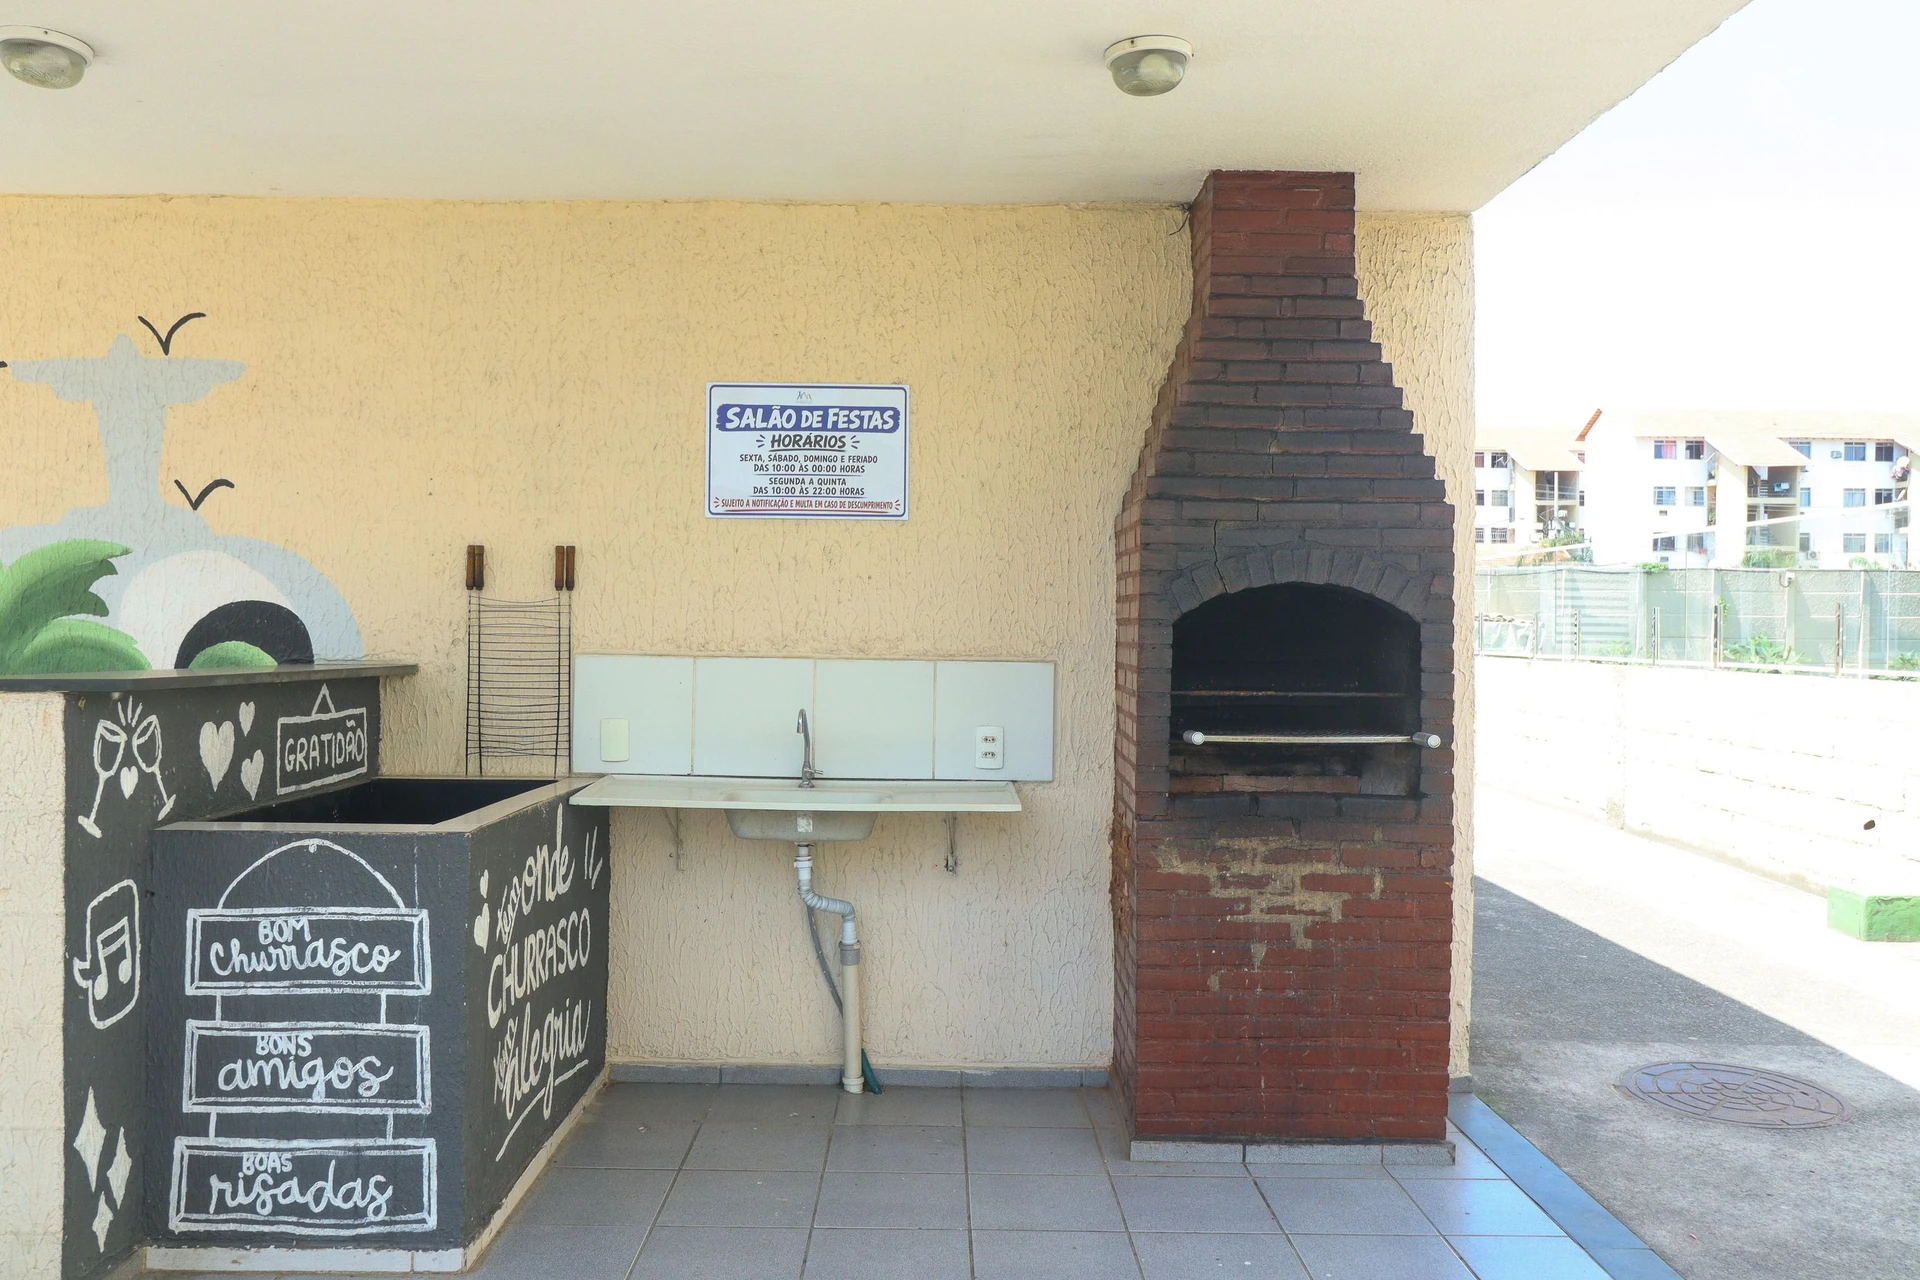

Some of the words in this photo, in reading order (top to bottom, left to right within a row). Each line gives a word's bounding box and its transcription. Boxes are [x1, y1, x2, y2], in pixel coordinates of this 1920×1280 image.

[725, 404, 797, 430] SALÃO
[800, 409, 824, 430] DE
[826, 407, 895, 430] FESTAS
[770, 432, 847, 449] HORÁRIOS
[739, 453, 765, 463] SEXTA,
[767, 452, 801, 464] SÁBADO,
[803, 454, 838, 463] DOMINGO
[840, 455, 846, 463] E
[848, 455, 878, 464] FERIADO
[753, 463, 770, 472] DAS
[772, 463, 796, 472] 10:00
[798, 462, 809, 473] ÀS
[811, 464, 837, 473] 00:00
[839, 465, 866, 474] HORAS
[753, 486, 769, 495] DAS
[771, 486, 796, 495] 10:00
[798, 485, 810, 495] ÀS
[812, 486, 837, 496] 22:00
[839, 487, 865, 496] HORAS
[768, 477, 806, 486] SEGUNDA
[808, 477, 814, 486] A
[817, 477, 847, 486] QUINTA
[721, 498, 745, 508] SUJEITO
[745, 499, 750, 508] A
[751, 497, 789, 510] NOTIFICAÇÃO
[789, 499, 794, 508] E
[795, 499, 813, 509] MULTA
[814, 500, 824, 509] EM
[824, 500, 838, 509] CASO
[839, 500, 847, 509] DE
[847, 500, 894, 510] DESCUMPRIMENTO
[284, 718, 365, 773] GRATIDÃO
[257, 916, 312, 946] BOM
[487, 908, 591, 1030] CHURRASCO
[255, 1033, 315, 1057] BONS
[217, 1053, 395, 1101] amigos
[241, 1151, 294, 1176] BOAS
[208, 1158, 395, 1217] risadas
